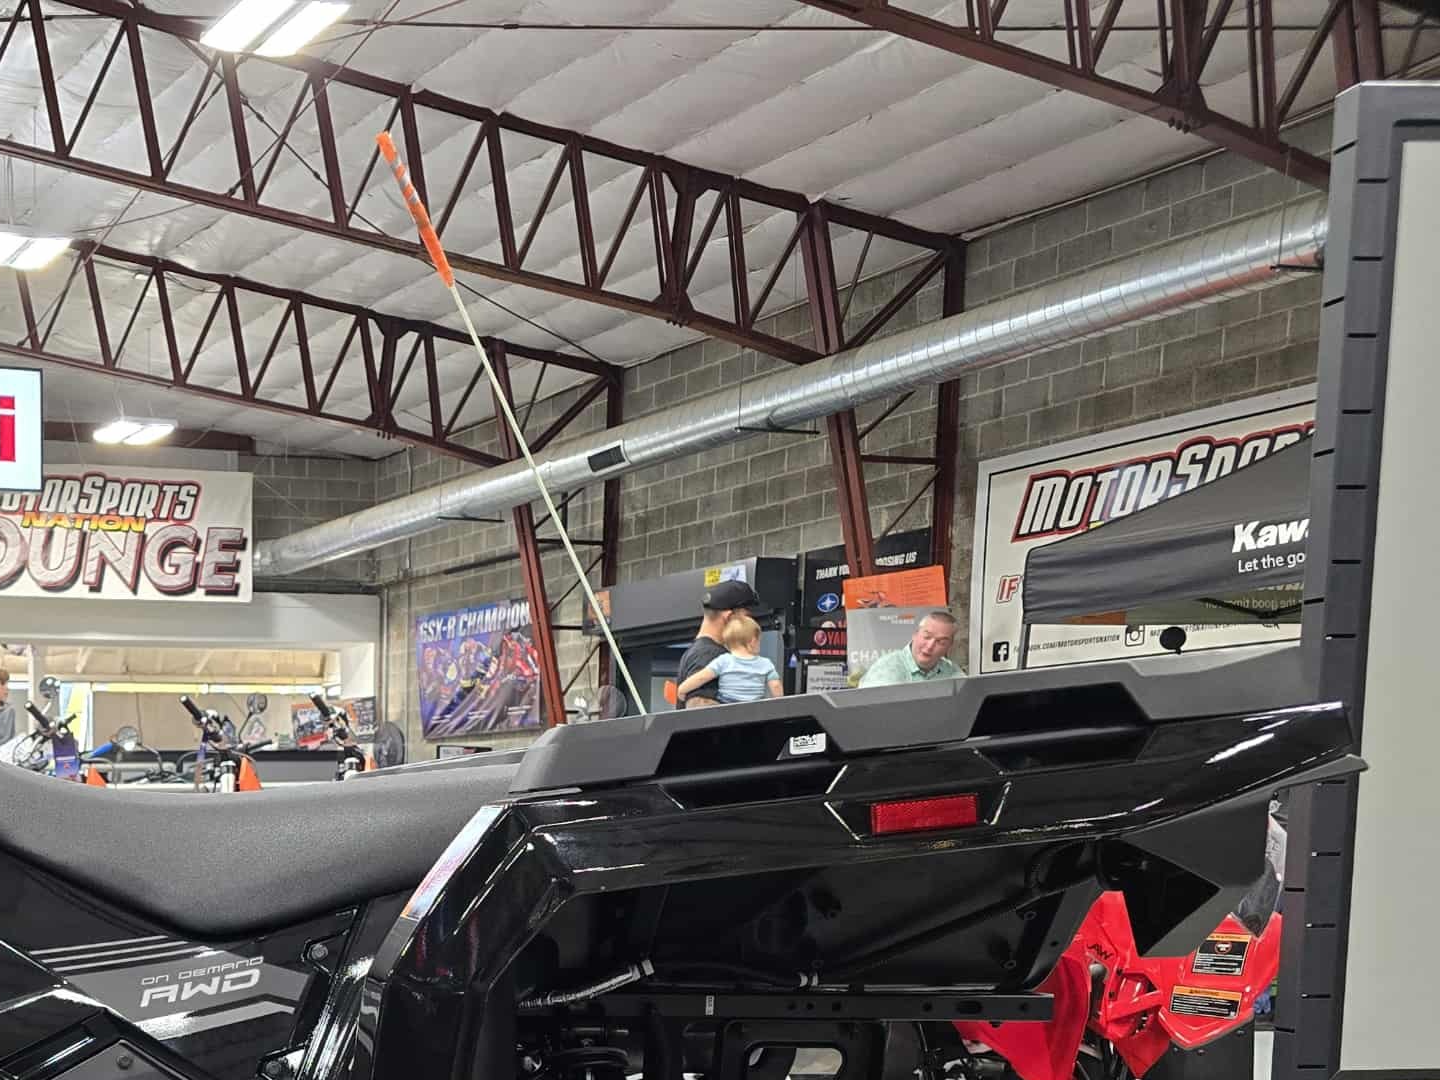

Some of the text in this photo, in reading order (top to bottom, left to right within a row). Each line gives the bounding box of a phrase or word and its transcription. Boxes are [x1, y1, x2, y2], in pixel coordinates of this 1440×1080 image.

[21, 512, 146, 532] NATION
[1232, 518, 1311, 553] Kaw
[905, 551, 918, 563] US
[1238, 559, 1259, 573] Let
[1261, 554, 1284, 569] the
[420, 617, 456, 641] GSX-R
[139, 968, 261, 1008] AWD
